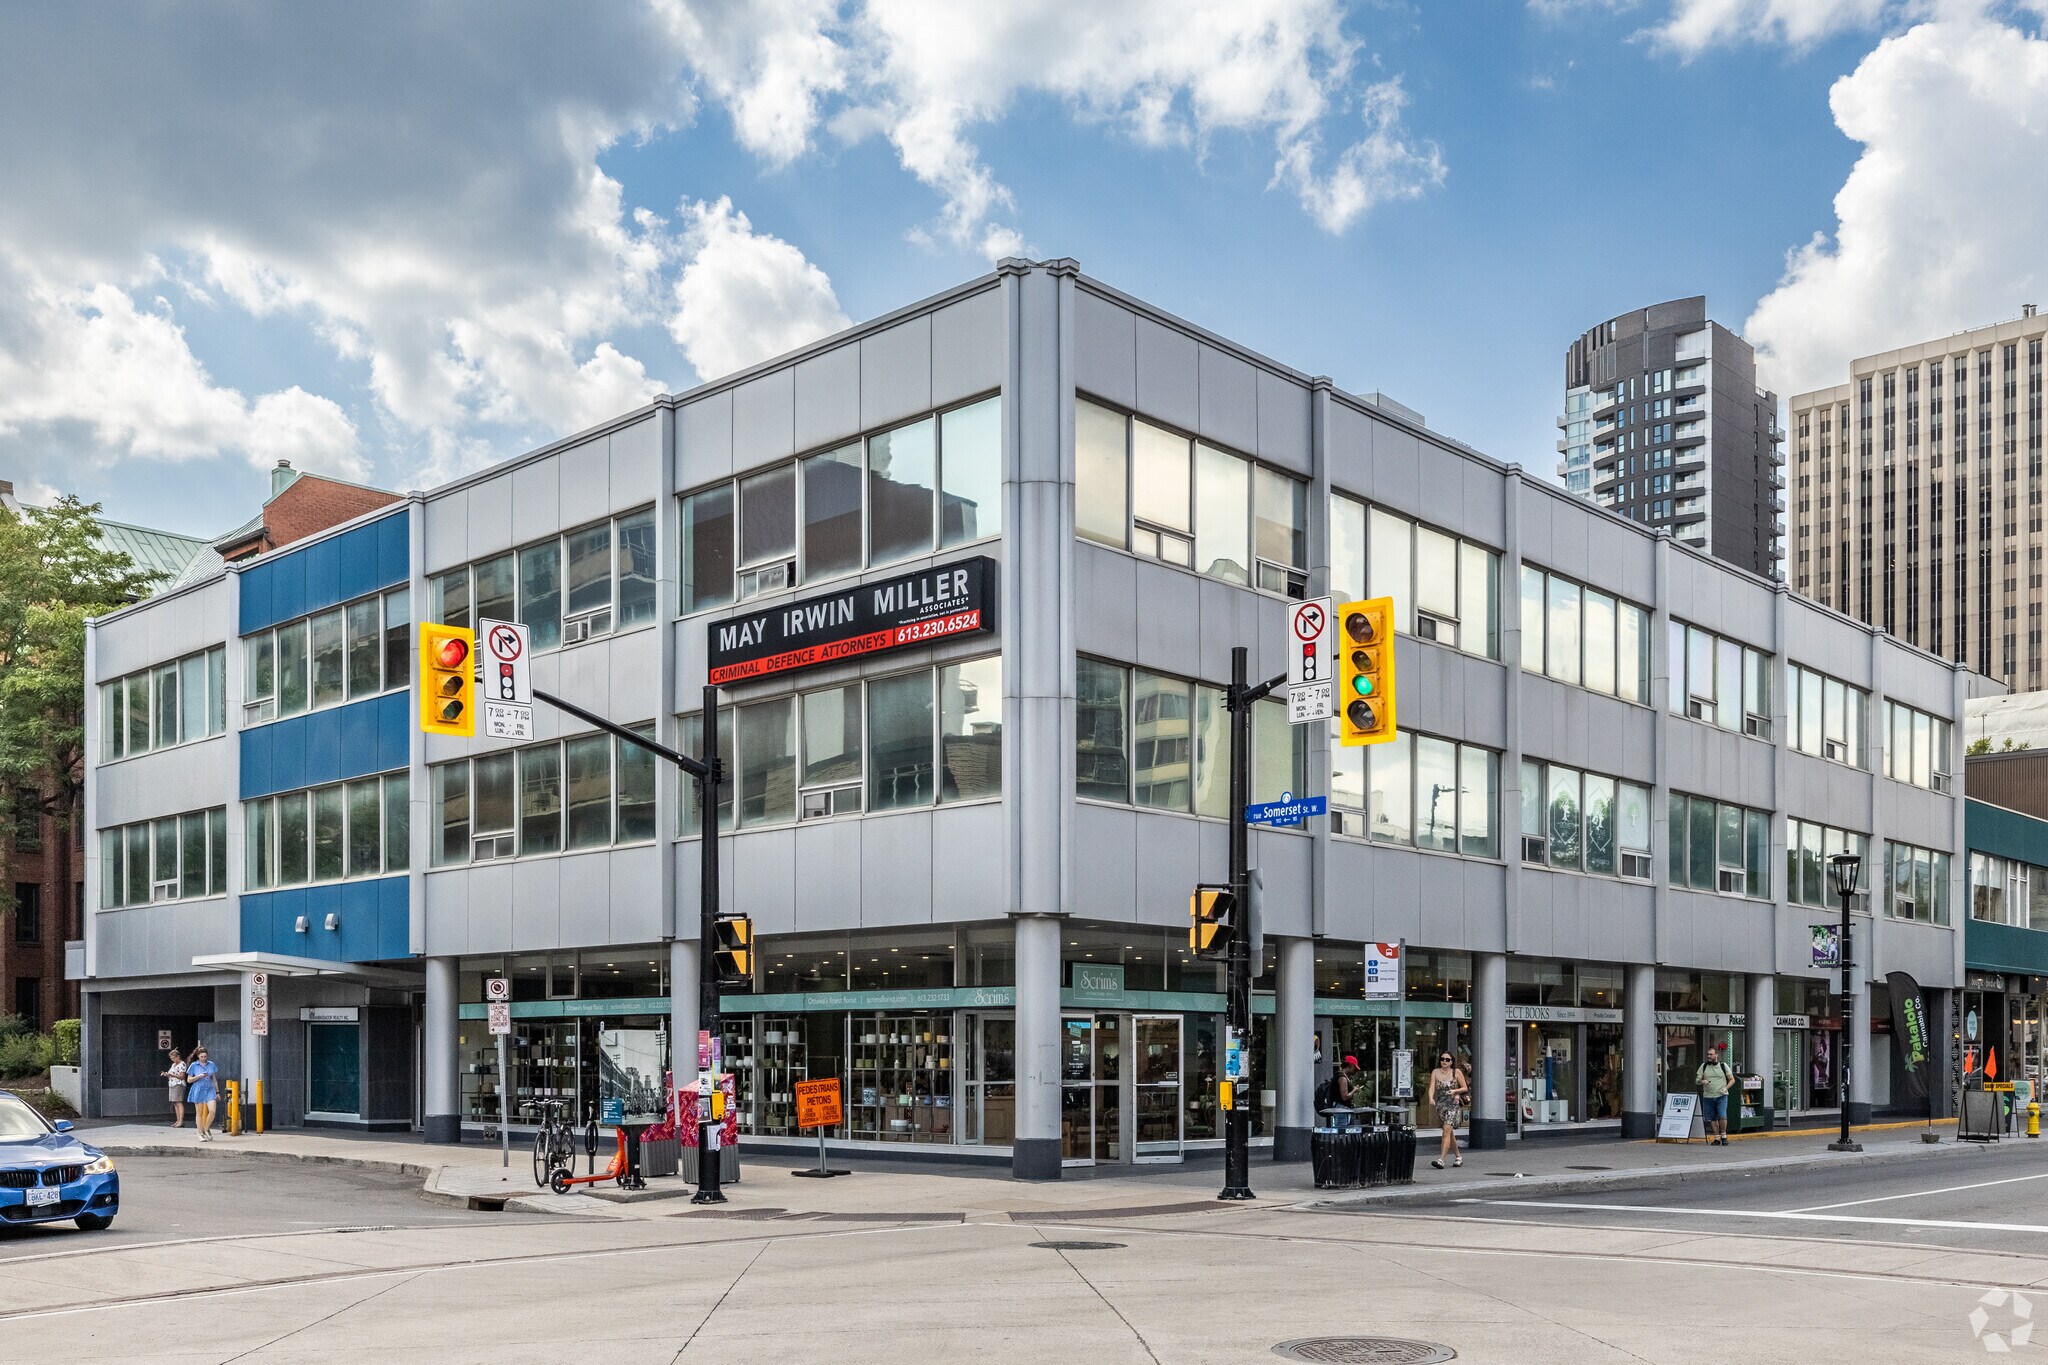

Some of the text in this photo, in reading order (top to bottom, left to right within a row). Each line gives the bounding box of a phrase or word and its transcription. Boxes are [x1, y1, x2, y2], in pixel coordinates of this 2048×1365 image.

[720, 568, 968, 652] MAY IRWIN MILLER
[898, 612, 978, 642] 613.230.6524
[713, 634, 886, 682] CRIMINAL DEFENCE ATTORNEYS
[1291, 693, 1295, 703] 7
[1315, 689, 1320, 699] 7
[489, 707, 493, 717] 7
[514, 710, 519, 719] 7
[1264, 804, 1301, 818] Somerset
[1526, 1007, 1550, 1019] BOOKS
[1776, 1017, 1797, 1026] CANNABIS
[799, 1083, 838, 1095] PEDESTRIANS
